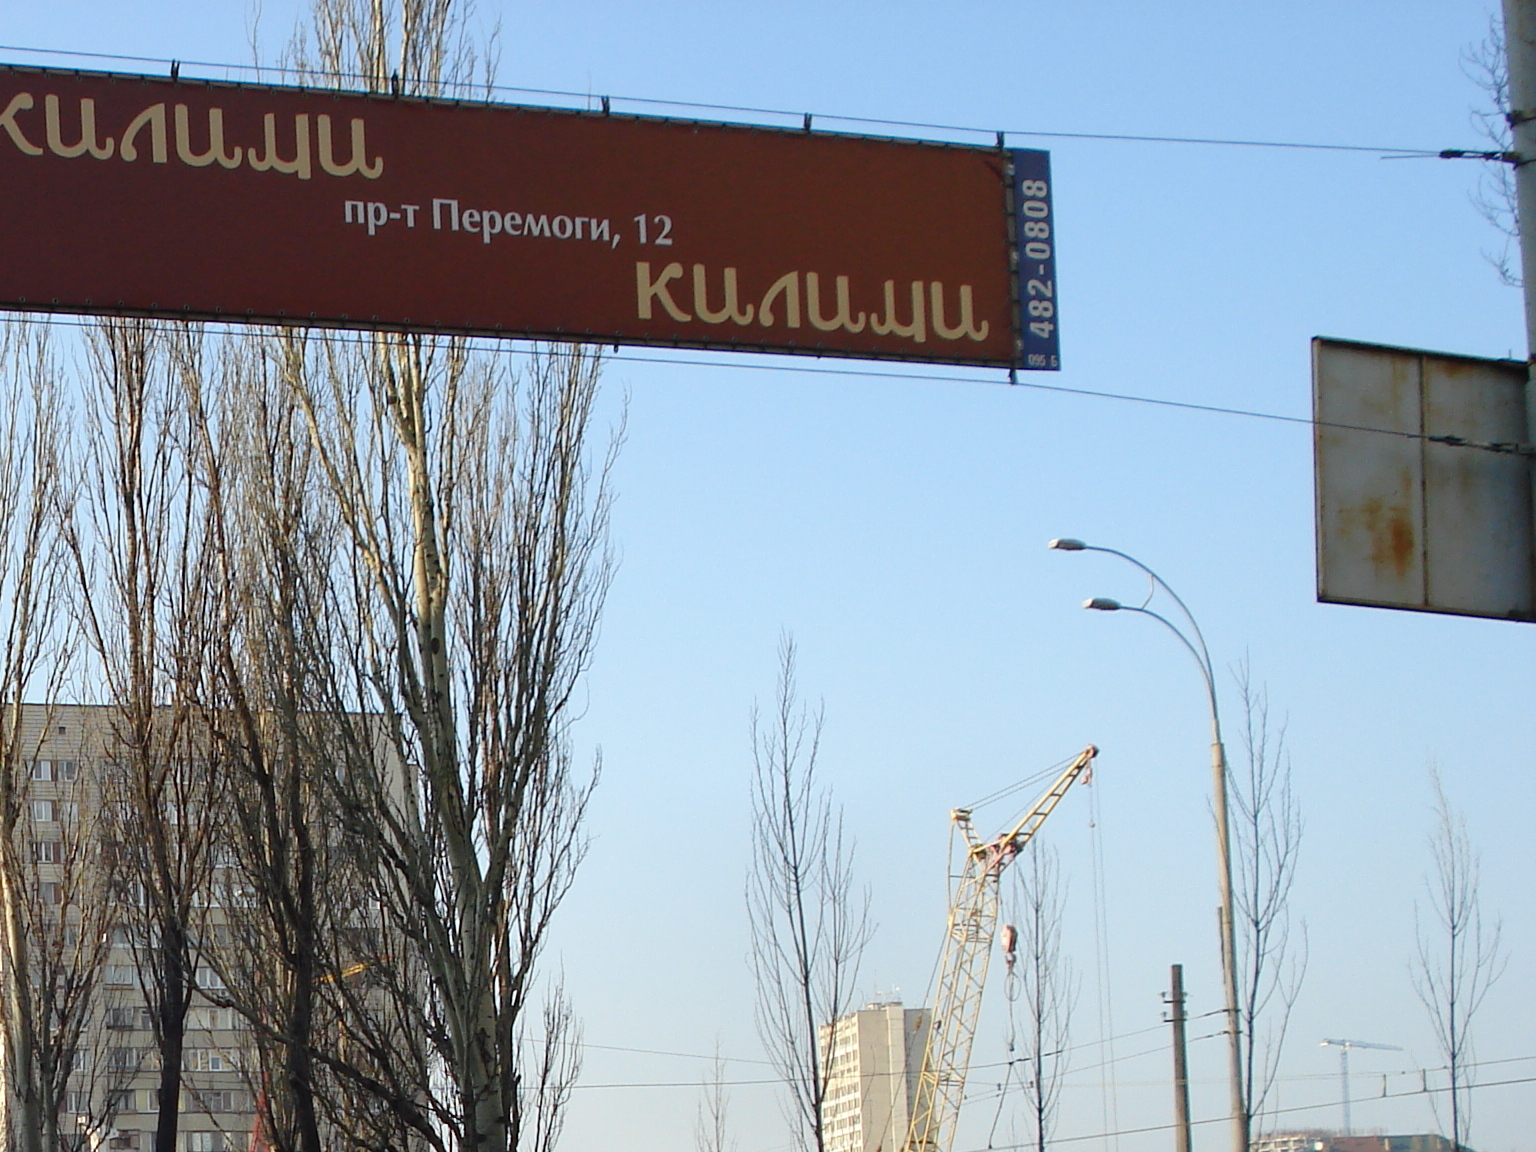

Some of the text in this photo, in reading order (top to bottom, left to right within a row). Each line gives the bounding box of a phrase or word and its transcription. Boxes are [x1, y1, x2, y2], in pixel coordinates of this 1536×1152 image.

[344, 197, 673, 250] пр-т Перемоги, 12
[1022, 179, 1055, 339] 482-0808
